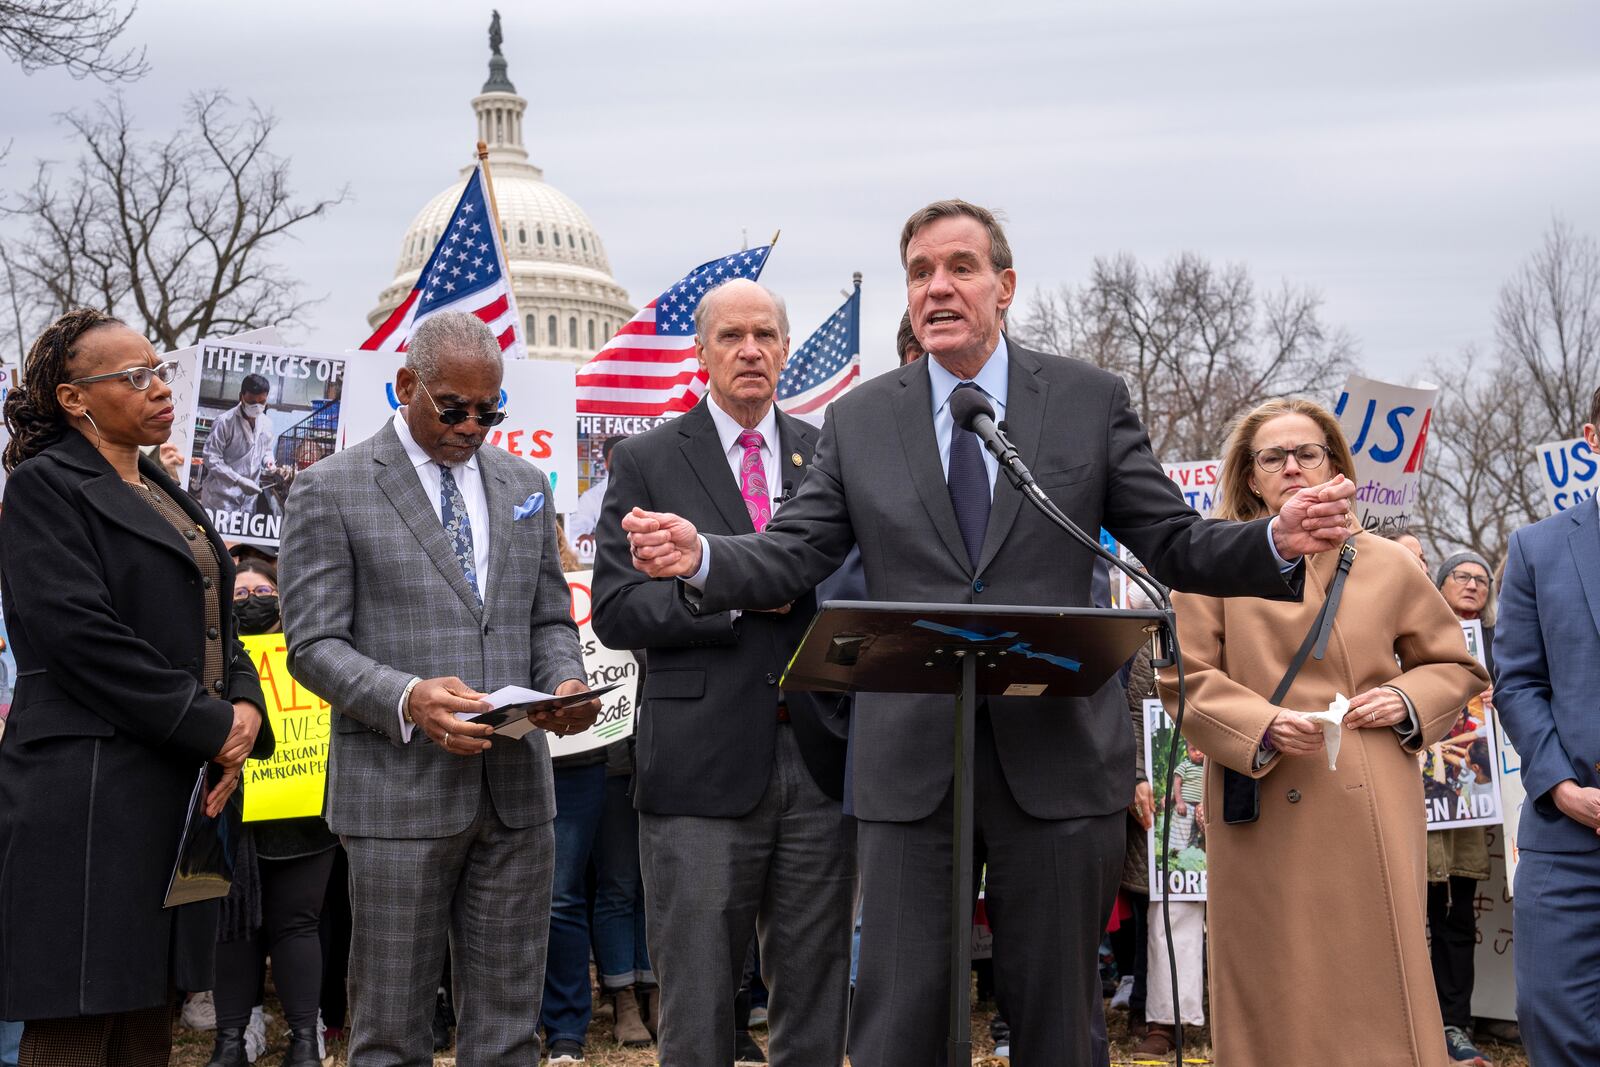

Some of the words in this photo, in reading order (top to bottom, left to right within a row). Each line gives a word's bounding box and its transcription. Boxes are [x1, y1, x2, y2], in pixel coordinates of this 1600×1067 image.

[205, 346, 245, 373] THE
[250, 352, 311, 379] FACES
[316, 359, 343, 383] OF
[577, 417, 601, 434] HE
[605, 417, 651, 435] FACES
[276, 713, 330, 745] IVES
[252, 763, 307, 783] AMERICAN
[1456, 793, 1494, 819] AID
